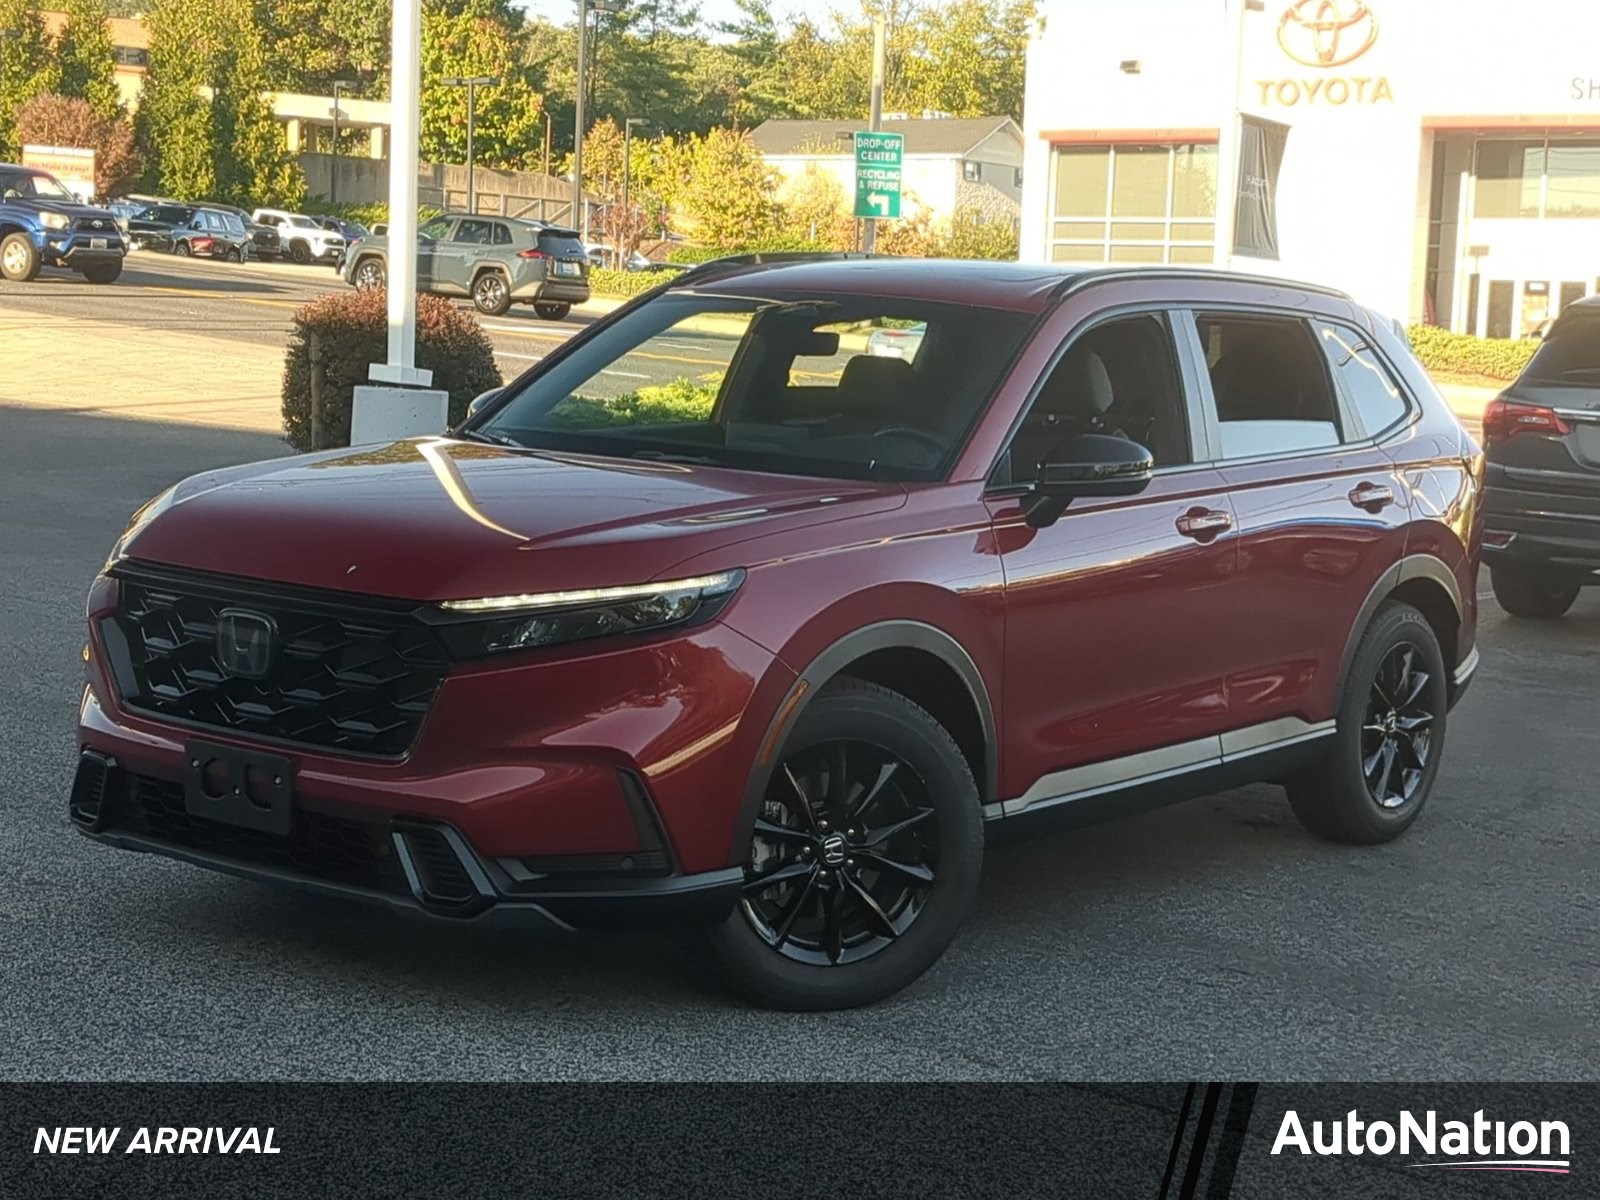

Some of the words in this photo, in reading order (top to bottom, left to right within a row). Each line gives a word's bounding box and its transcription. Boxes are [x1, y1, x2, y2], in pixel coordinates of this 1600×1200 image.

[1256, 77, 1394, 106] TOYOTA
[857, 138, 900, 149] DROP-OFF
[861, 151, 897, 161] CENTER
[857, 169, 900, 180] RECYCLING
[867, 181, 899, 191] REFUSE
